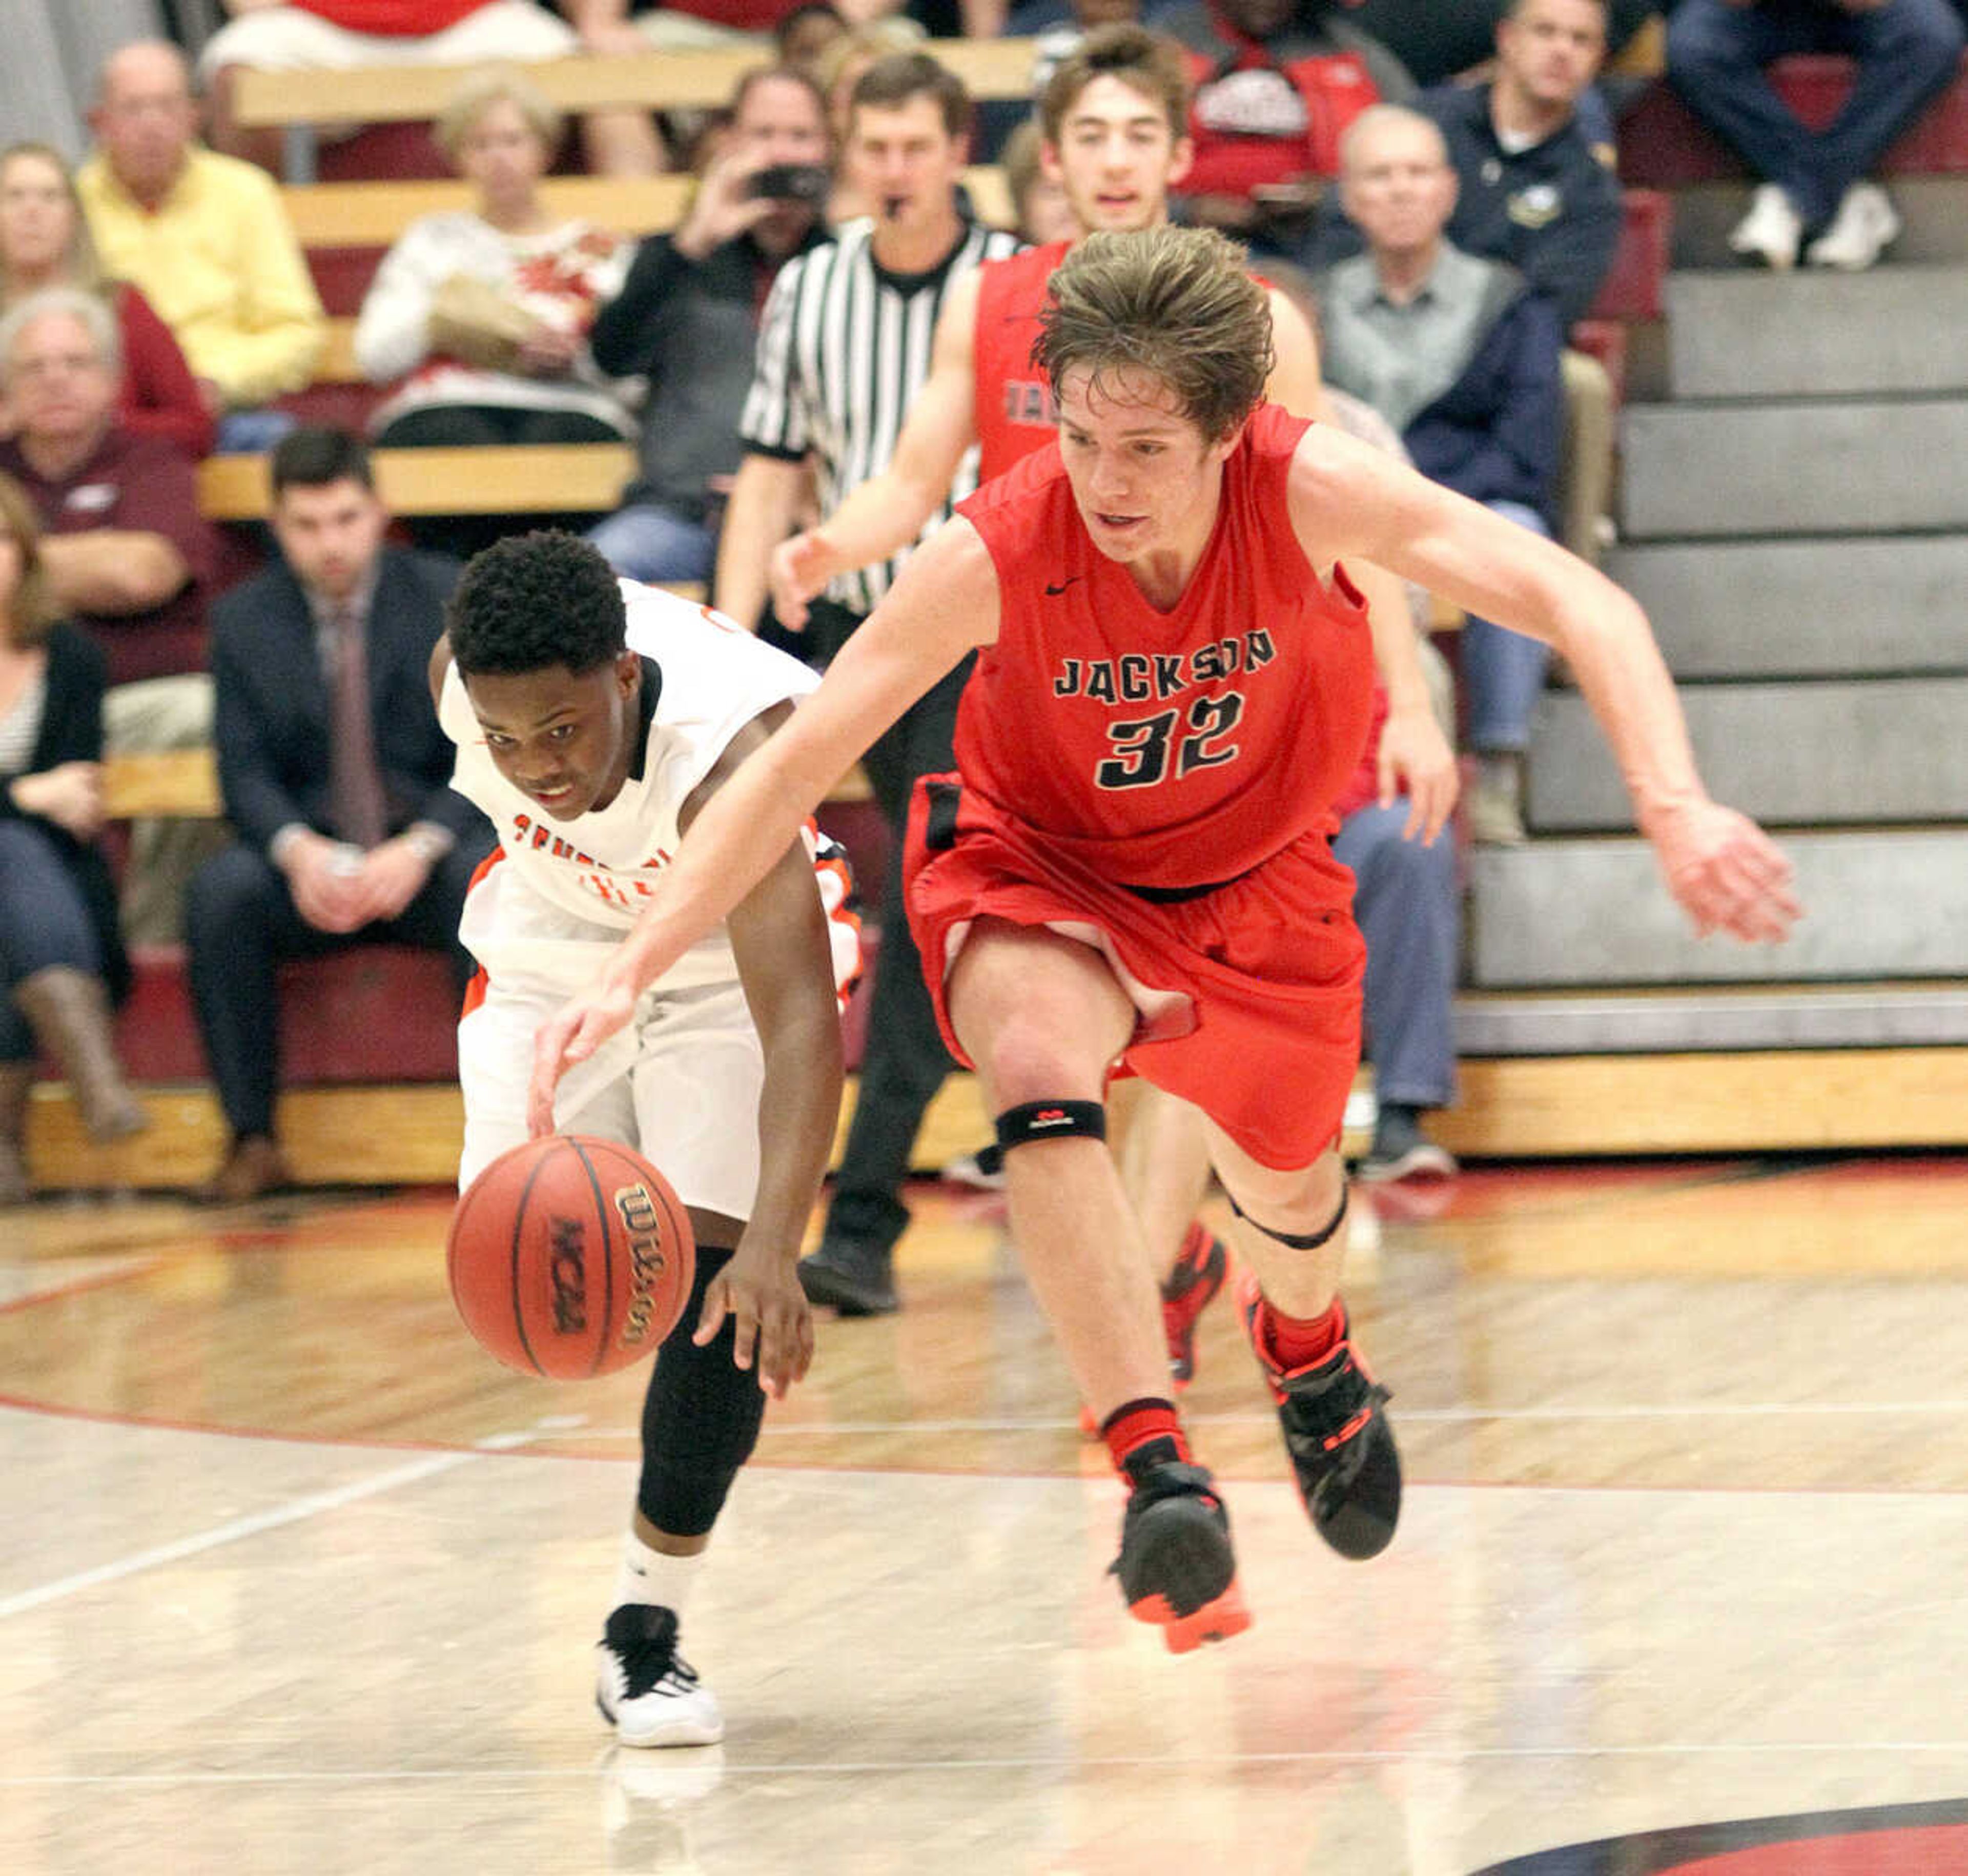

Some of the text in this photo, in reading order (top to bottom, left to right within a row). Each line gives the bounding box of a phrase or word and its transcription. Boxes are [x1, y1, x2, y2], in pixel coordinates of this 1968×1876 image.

[1054, 628, 1275, 705] JACKSON
[1095, 691, 1244, 790] 32
[549, 1214, 585, 1335] NCAA
[614, 1182, 664, 1350] Wilson
